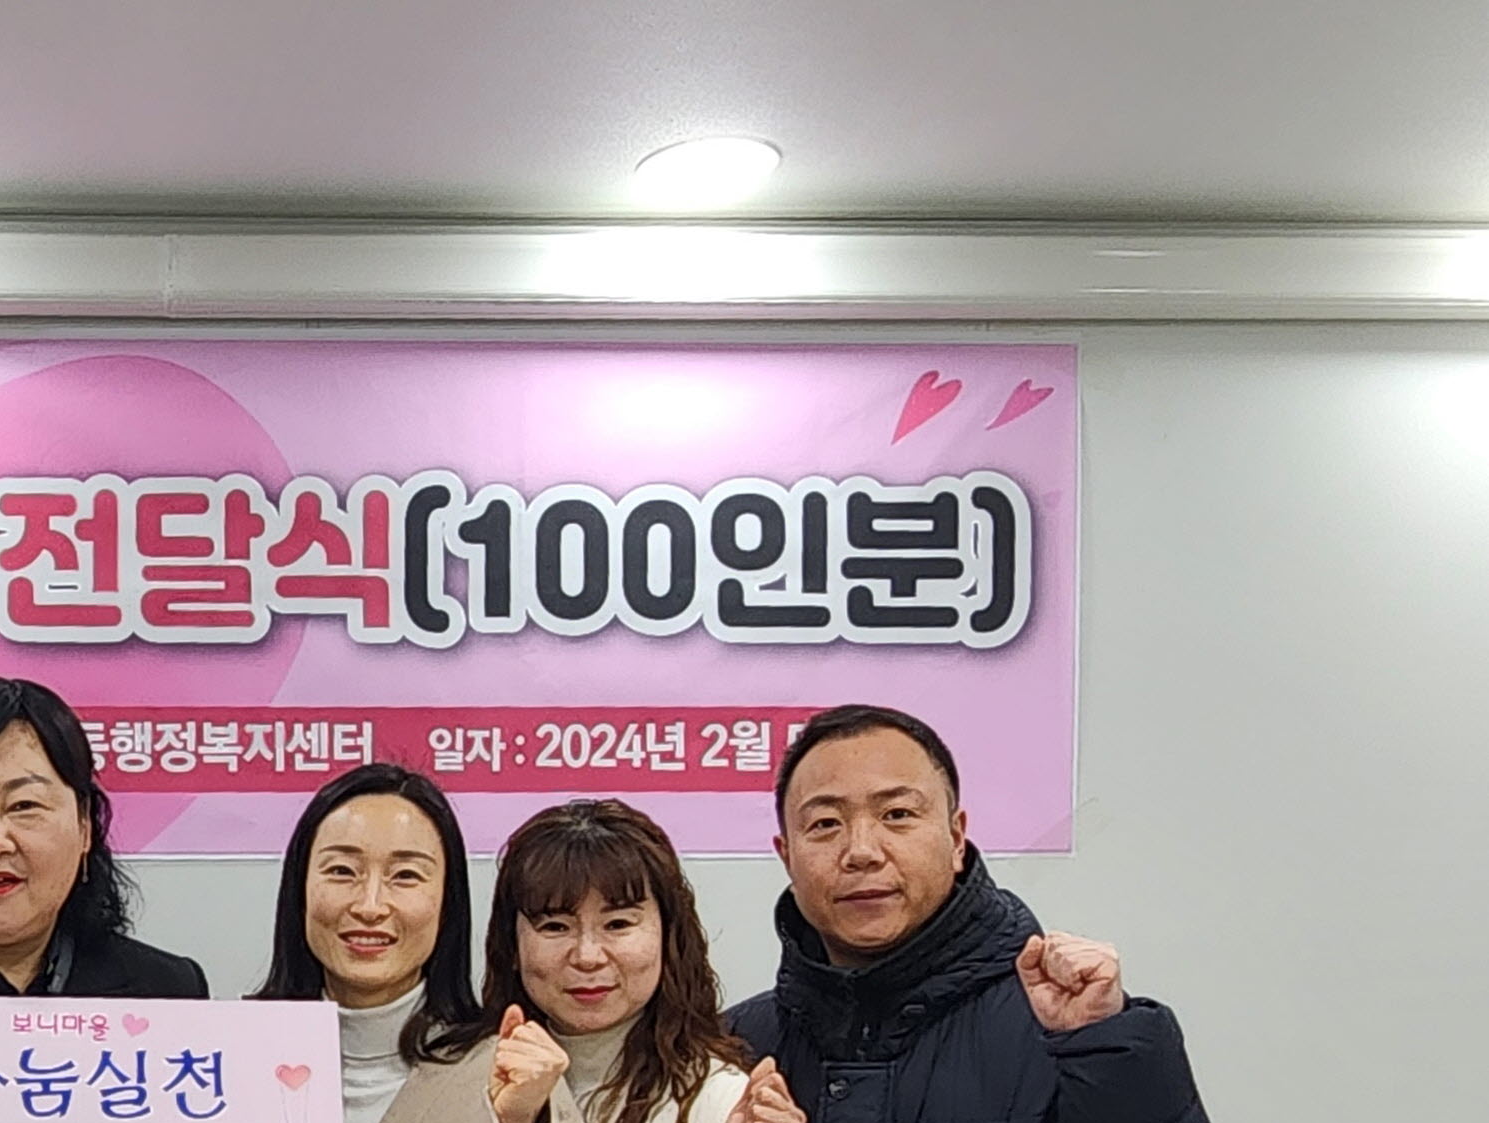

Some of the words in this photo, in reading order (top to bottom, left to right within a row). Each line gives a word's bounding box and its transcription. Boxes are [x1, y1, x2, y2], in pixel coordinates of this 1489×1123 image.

[534, 721, 687, 772] 2024년
[700, 721, 772, 774] 2월
[11, 1013, 111, 1041] 보니마을
